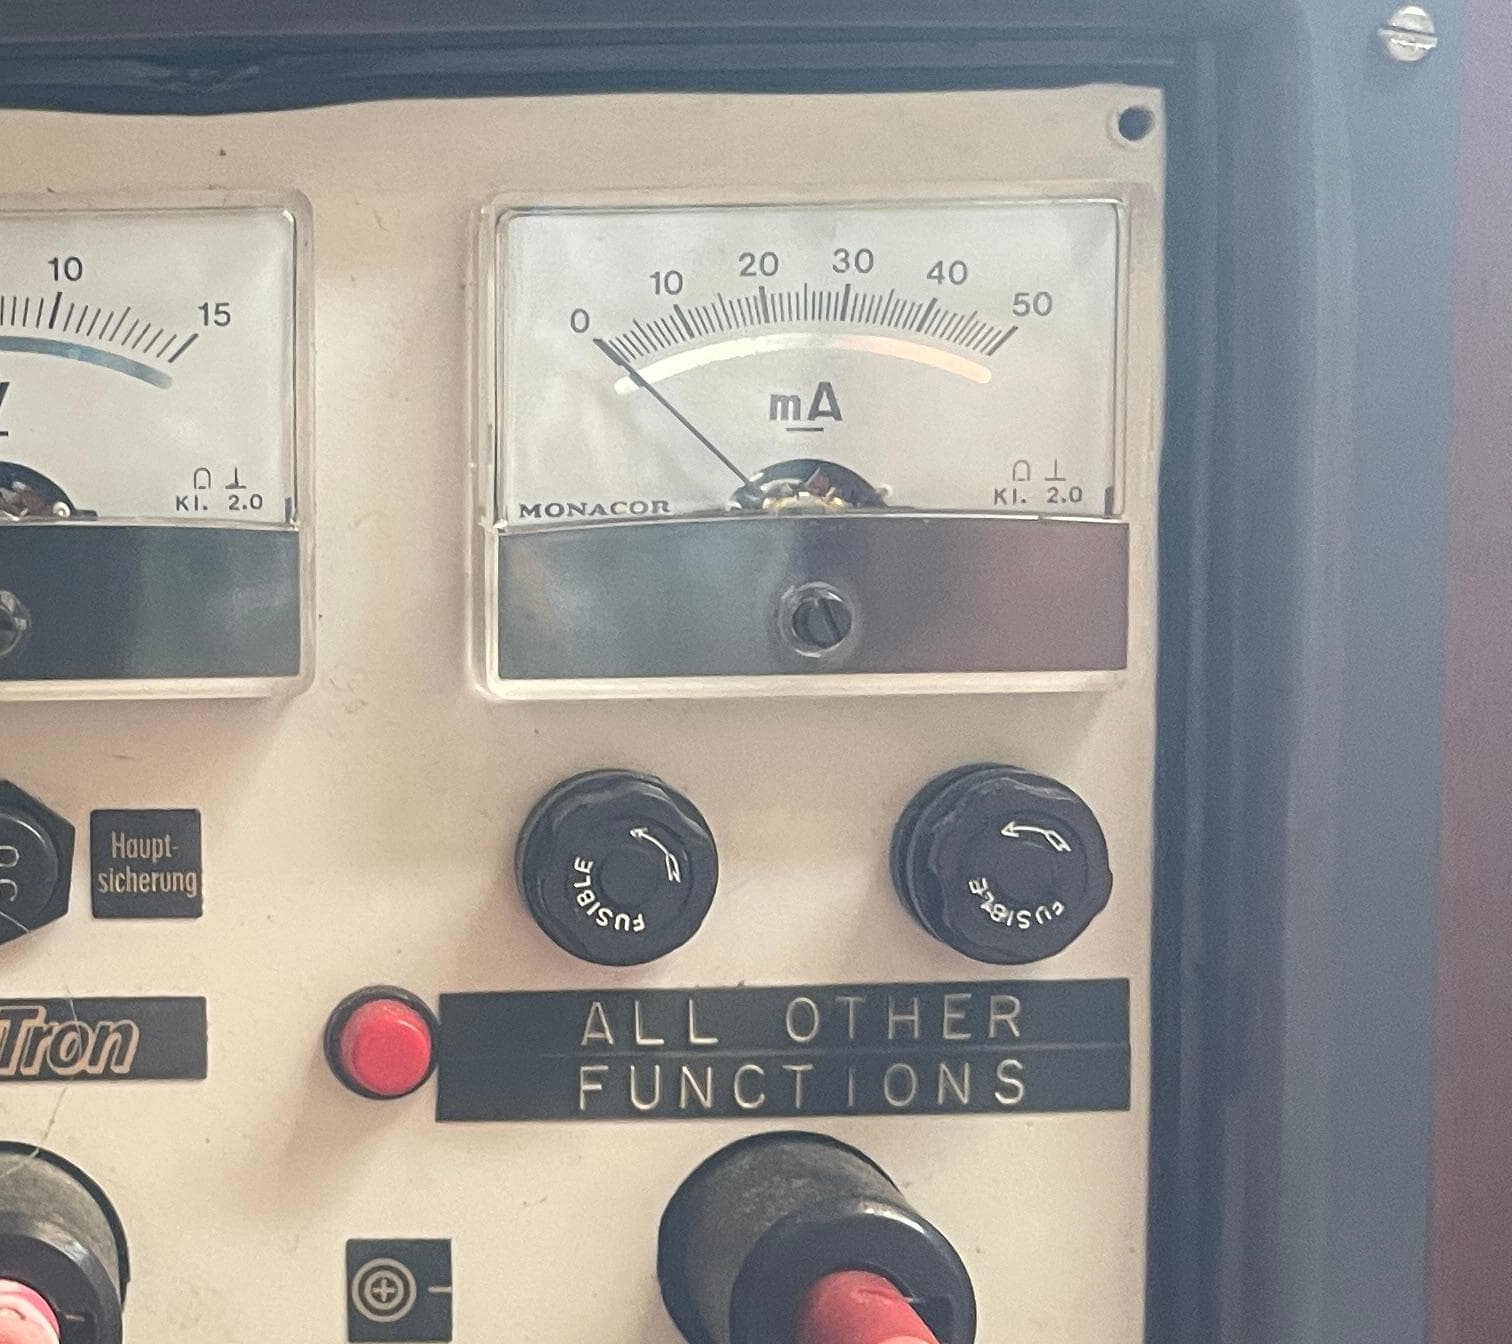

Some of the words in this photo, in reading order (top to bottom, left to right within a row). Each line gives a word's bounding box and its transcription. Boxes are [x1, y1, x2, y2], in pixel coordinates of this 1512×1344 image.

[48, 255, 84, 283] 10
[198, 301, 232, 329] 15
[570, 307, 591, 335] 0
[649, 270, 685, 298] 10
[737, 250, 780, 279] 20
[831, 247, 875, 276] 30
[925, 259, 968, 288] 40
[1011, 290, 1054, 319] 50
[768, 380, 844, 423] mA
[226, 493, 263, 512] 2.0
[518, 499, 671, 519] MONACOR
[1045, 485, 1083, 505] 2.0
[110, 831, 179, 864] Haupt-
[96, 866, 198, 899] sicherung
[572, 856, 646, 934] FUSIBLE
[967, 876, 1065, 929] FUSIBLE
[579, 997, 719, 1047] ALL
[785, 993, 1024, 1045] OTHER
[577, 1059, 1027, 1112] FUNCTIONS
